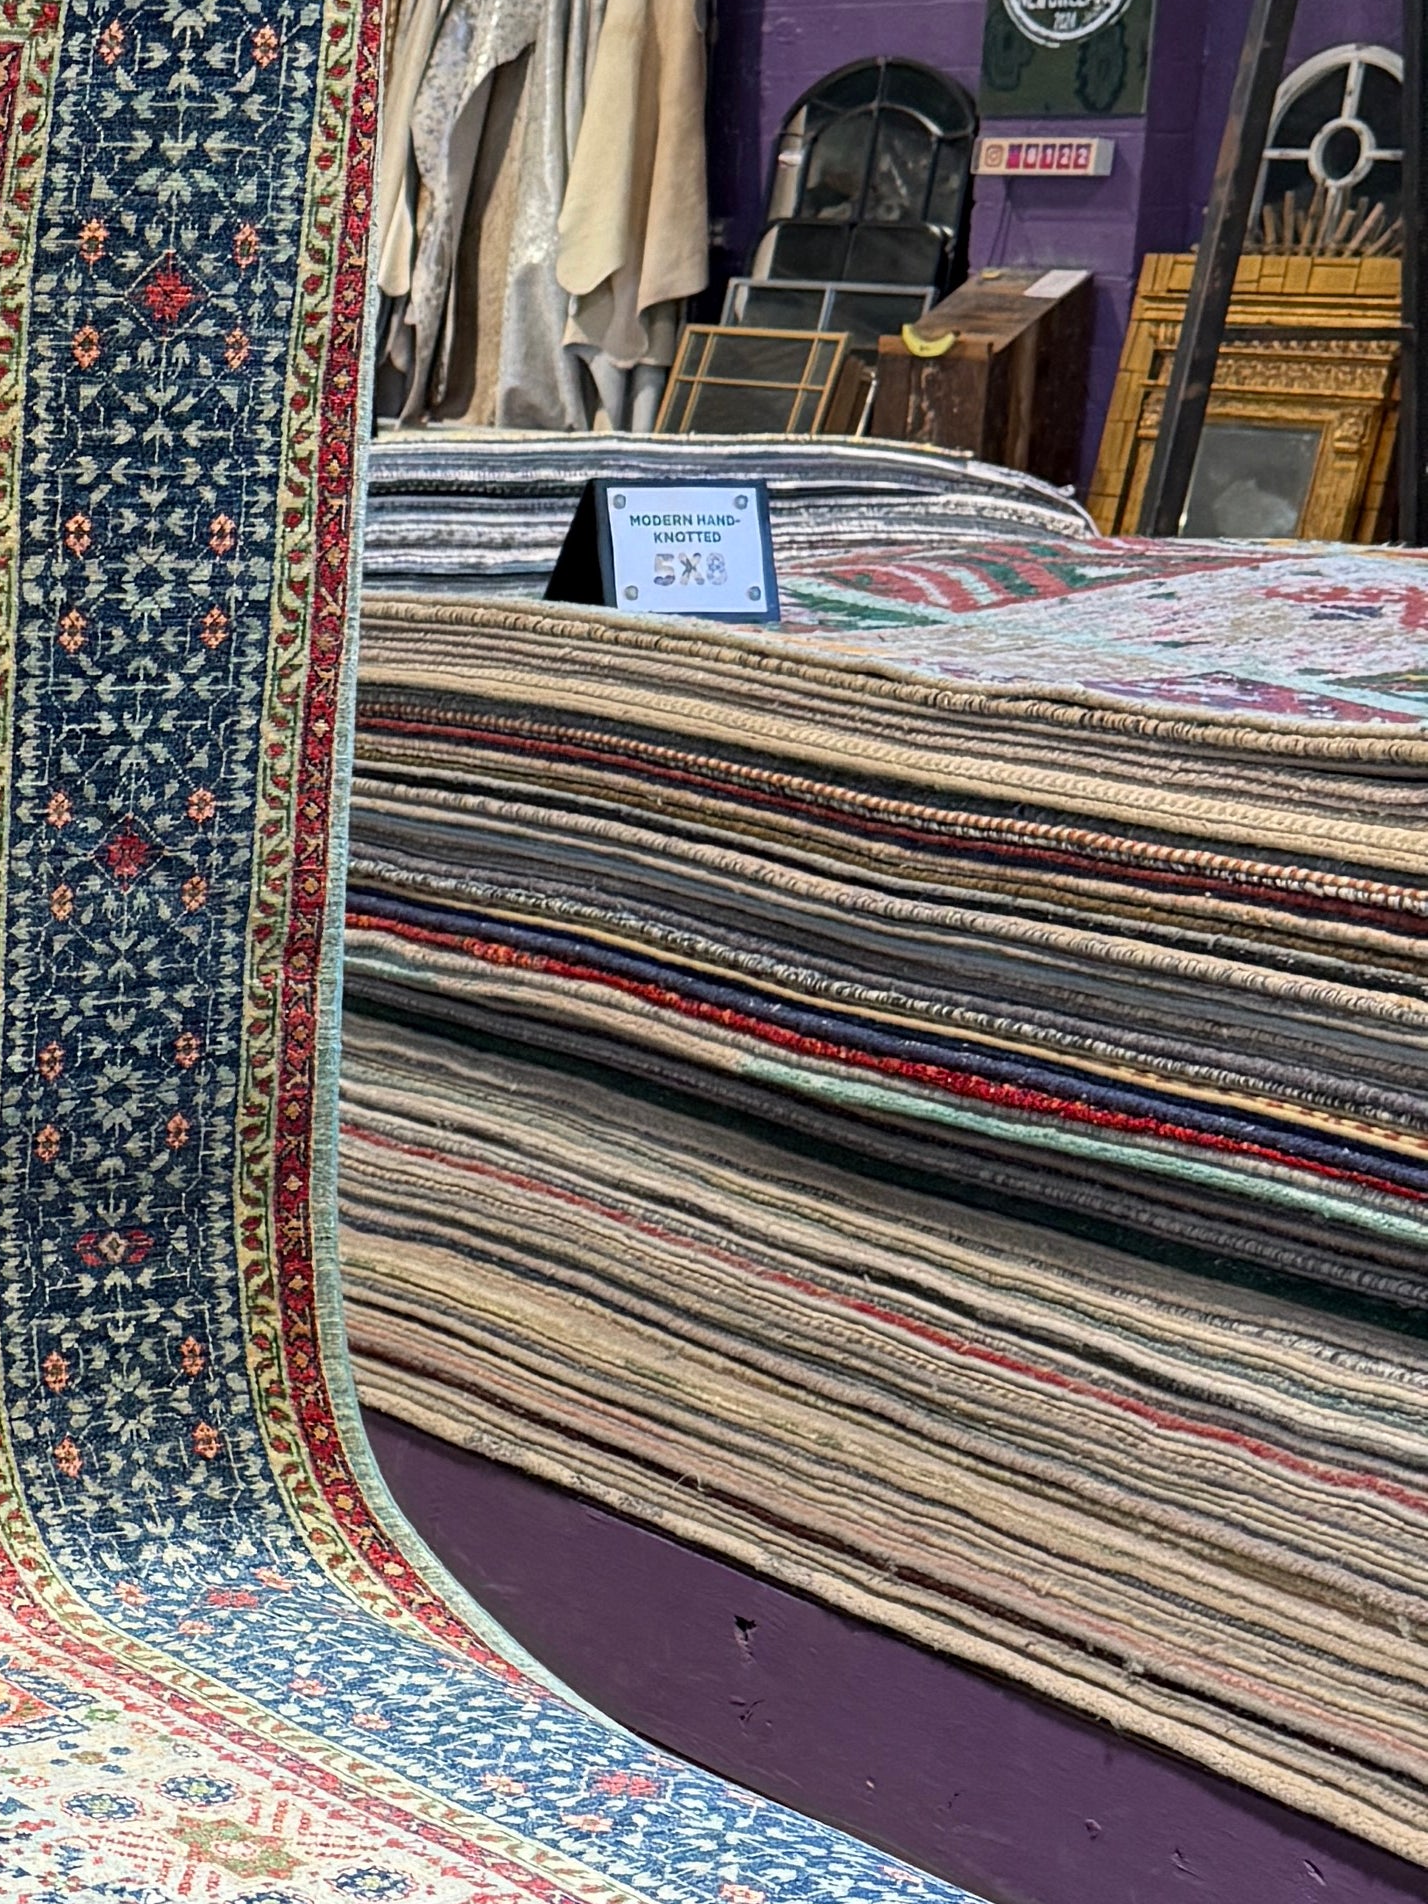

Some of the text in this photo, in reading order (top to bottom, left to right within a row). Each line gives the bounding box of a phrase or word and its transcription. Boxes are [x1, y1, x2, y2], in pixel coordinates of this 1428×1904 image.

[629, 514, 741, 527] MODERN HAND-
[653, 531, 722, 544] KNOTTED
[653, 552, 728, 586] 5X8
